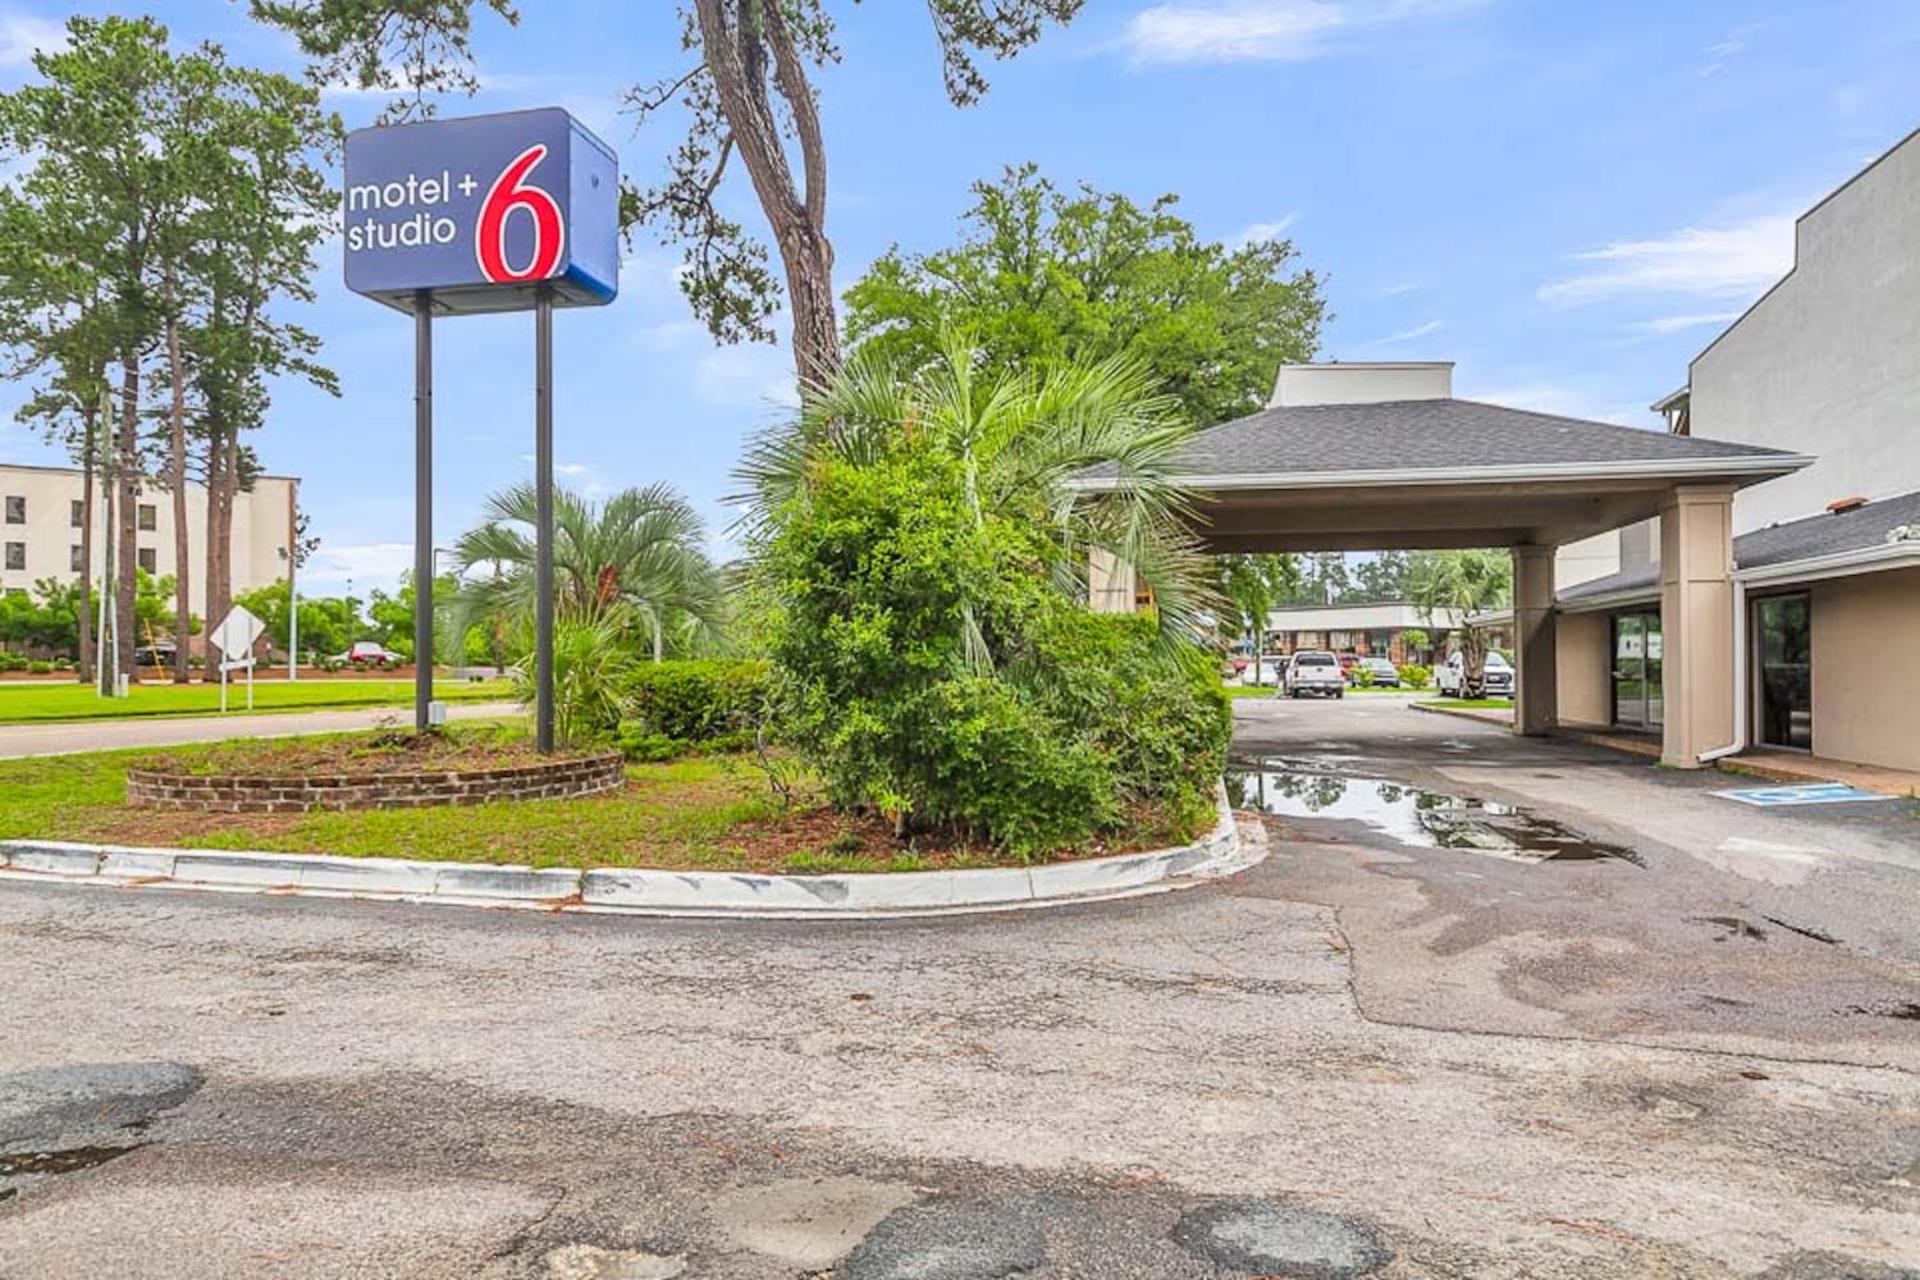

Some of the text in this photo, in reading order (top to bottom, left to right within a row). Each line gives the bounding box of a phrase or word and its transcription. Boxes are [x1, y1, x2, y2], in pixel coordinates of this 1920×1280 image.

[349, 171, 449, 210] motel
[348, 213, 456, 250] studio
[475, 144, 565, 283] 6
